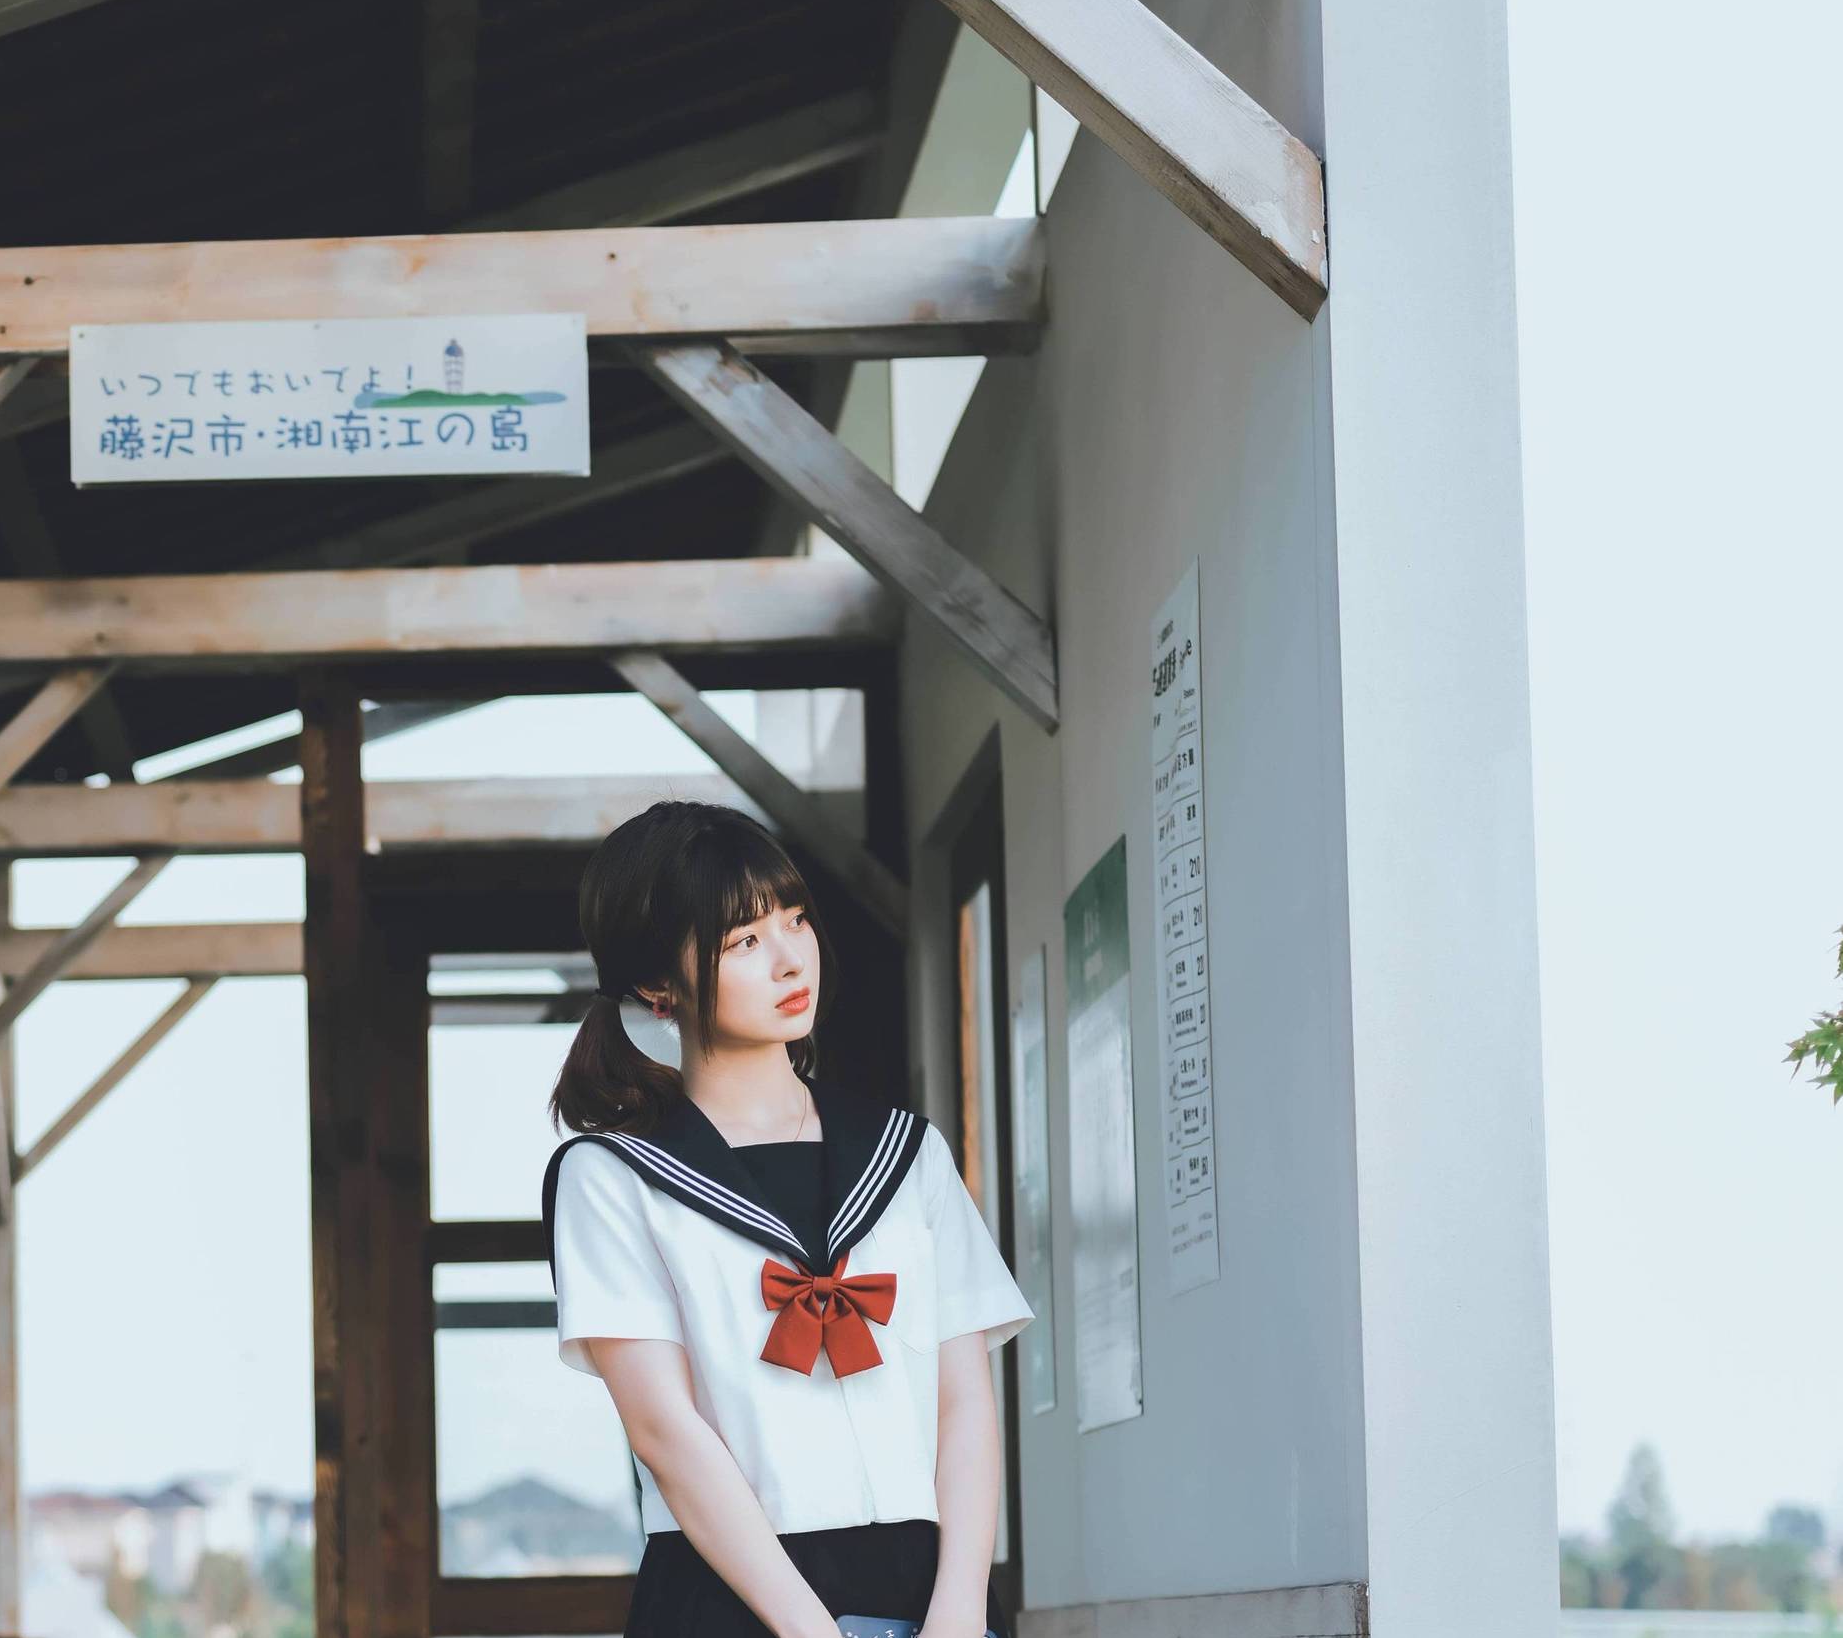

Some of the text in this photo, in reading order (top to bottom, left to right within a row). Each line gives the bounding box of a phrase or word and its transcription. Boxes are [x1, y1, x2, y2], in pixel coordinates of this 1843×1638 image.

[99, 403, 530, 461] 藤沢市・湘南江の島
